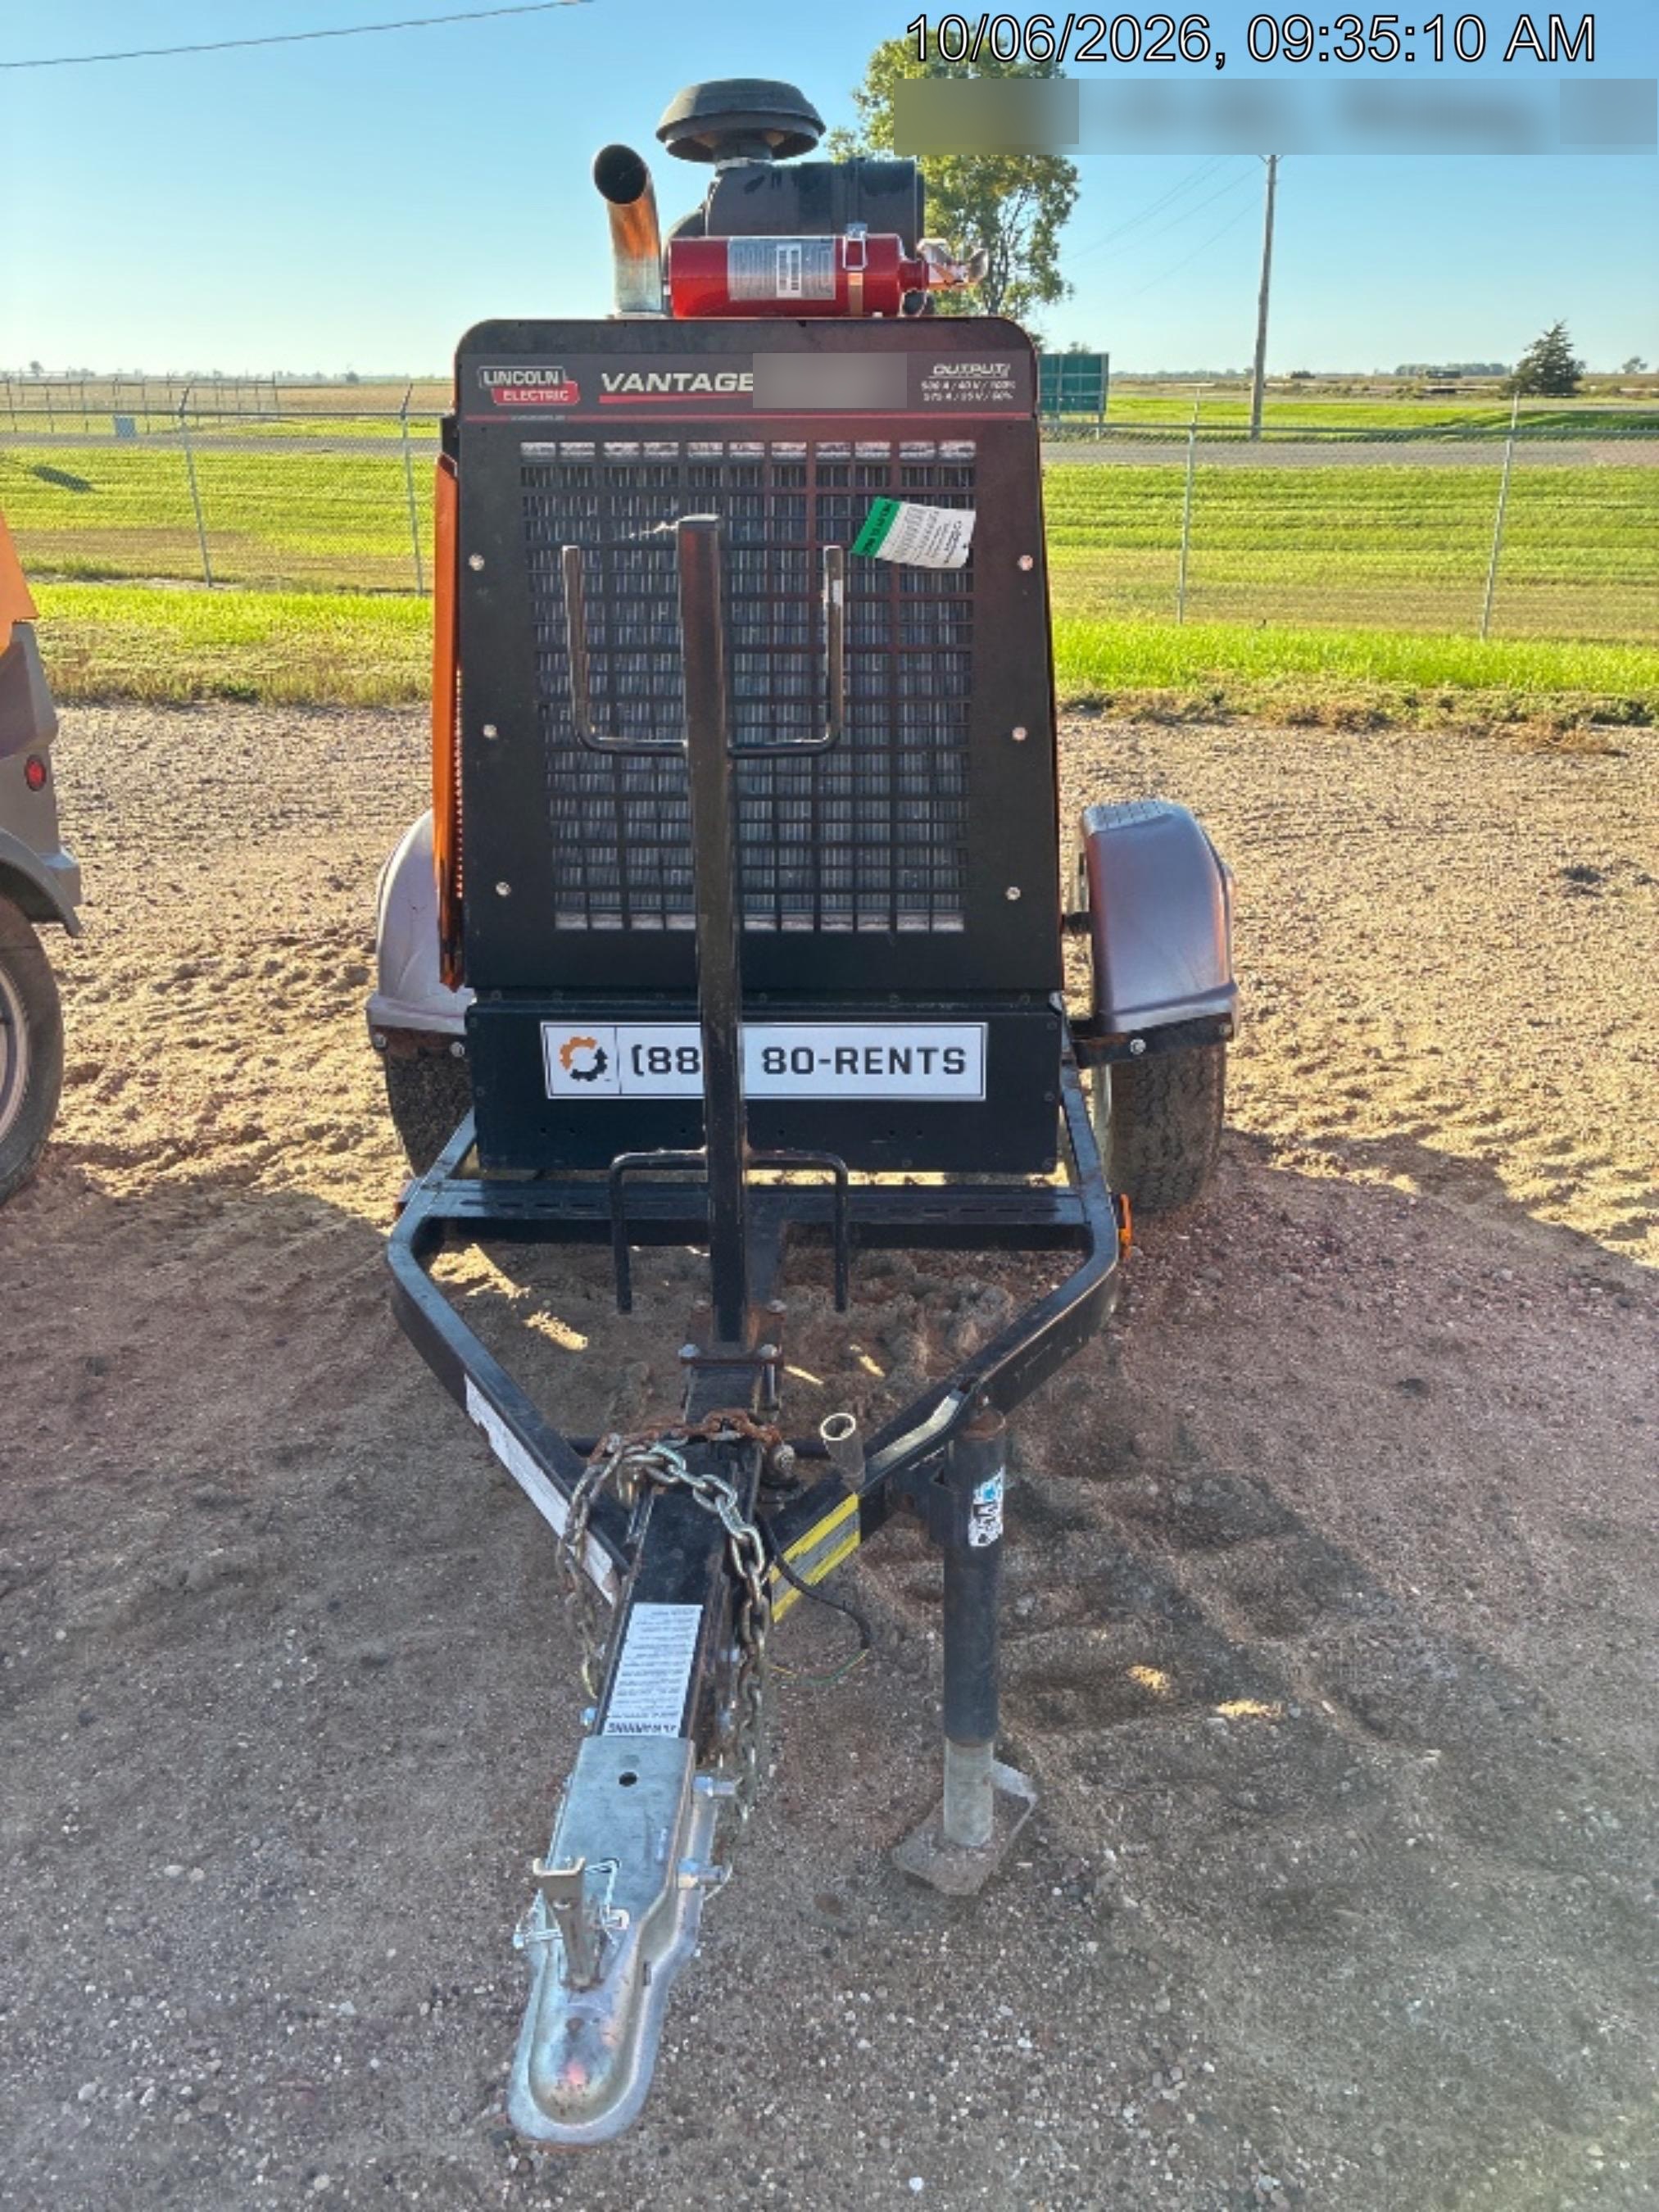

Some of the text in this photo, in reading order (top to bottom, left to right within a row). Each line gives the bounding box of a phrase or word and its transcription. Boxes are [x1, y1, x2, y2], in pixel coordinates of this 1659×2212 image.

[483, 370, 559, 385] LINCOLN
[601, 373, 753, 392] VANTAGE
[503, 390, 569, 401] ELECTRIC
[632, 1044, 966, 1076] (88 80-RENTS
